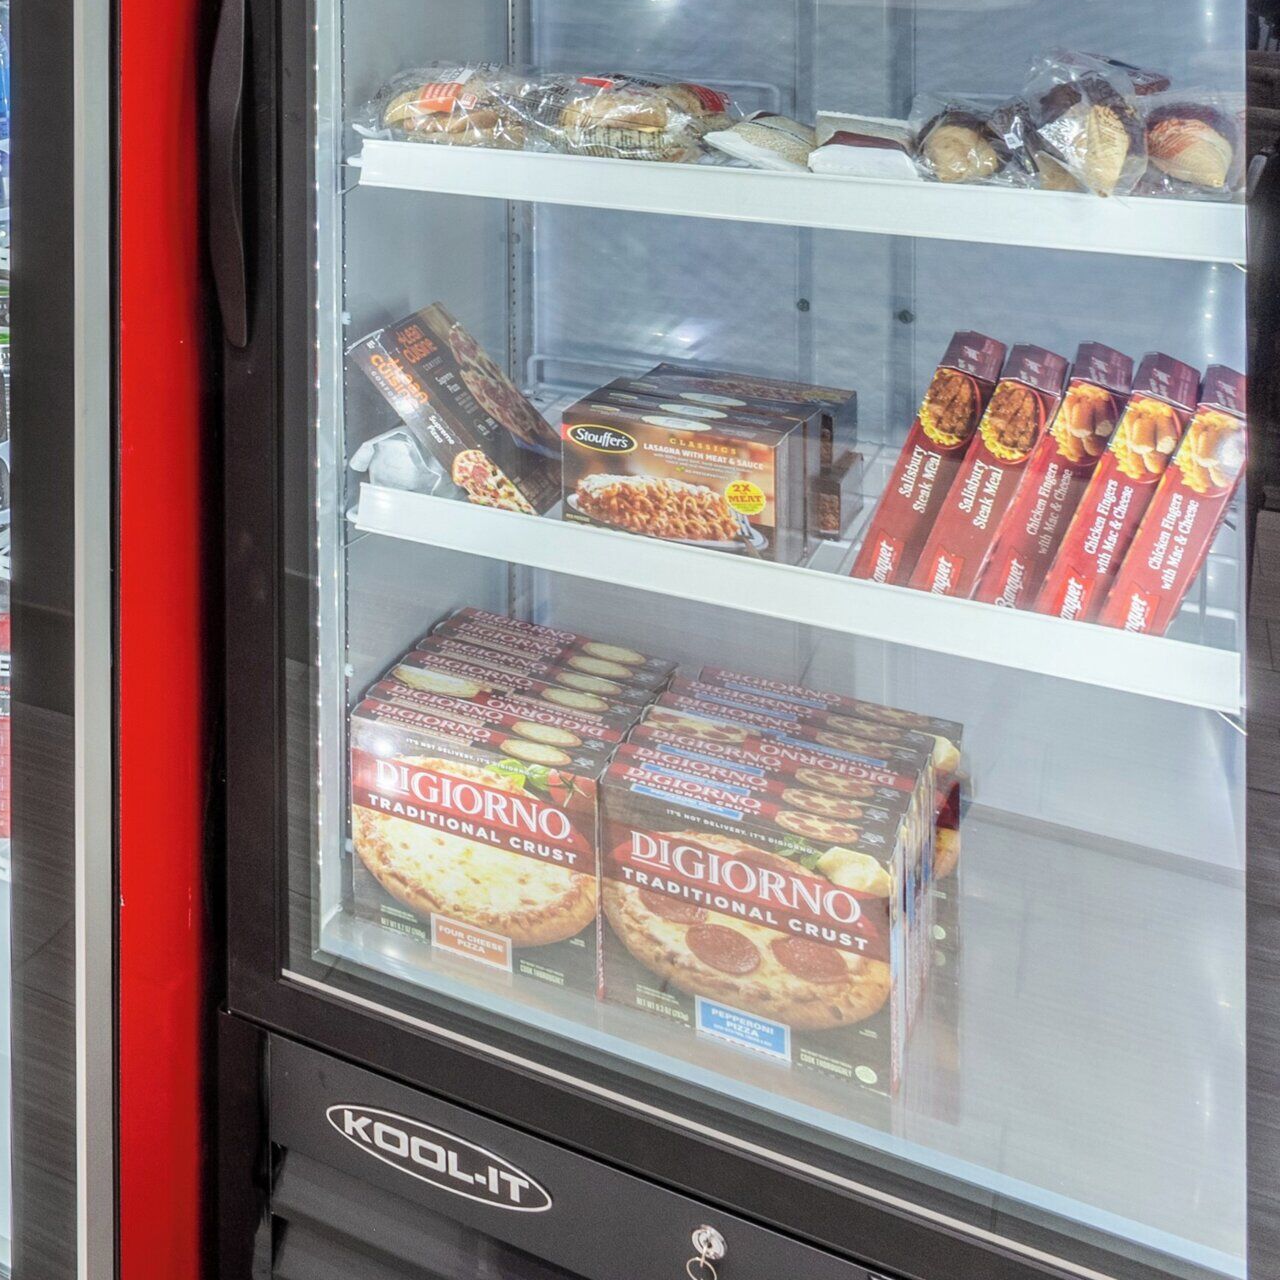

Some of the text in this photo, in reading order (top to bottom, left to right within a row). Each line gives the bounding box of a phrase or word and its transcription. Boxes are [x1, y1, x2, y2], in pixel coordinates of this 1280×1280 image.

[427, 425, 444, 444] Pizza
[429, 415, 455, 445] Supreme
[576, 428, 628, 449] Stouffer's
[669, 437, 737, 455] CLASSICS
[643, 443, 680, 456] LASAGNA
[682, 449, 704, 460] WITH
[706, 454, 728, 465] MEAT
[737, 459, 764, 471] SAUCE
[898, 444, 927, 498] Salisbury
[728, 495, 762, 503] MEAT
[732, 484, 750, 493] 2X
[912, 450, 942, 513] Steak Meal
[958, 459, 989, 513] Salisbury
[972, 465, 1004, 530] Steak Meal
[1026, 462, 1059, 536] Chicken Fingers
[1039, 469, 1074, 555] with Mac & Cheese
[1084, 479, 1119, 555] Chicken Fingers
[1097, 485, 1134, 574] with Mac & Cheese
[1148, 493, 1183, 570] Chicken Fingers
[1161, 499, 1200, 591] with Mac & Cheese
[377, 703, 491, 739] DIGIORNO
[392, 685, 504, 721] DIGIORNO
[421, 741, 435, 751] NOT
[636, 747, 768, 787] DIGIORNO
[626, 766, 762, 810] DIGIORNO
[368, 794, 577, 865] TRADITIONAL CRUST
[666, 809, 767, 840] IT'S NOT IT'S
[622, 866, 869, 951] TRADITIONAL CRUST
[439, 925, 504, 953] FOUR CHEESE
[457, 939, 485, 954] PIZZA
[711, 1007, 774, 1035] PEPPERONI
[726, 1020, 759, 1038] PIZZA
[342, 1109, 530, 1203] KOOL-IT
